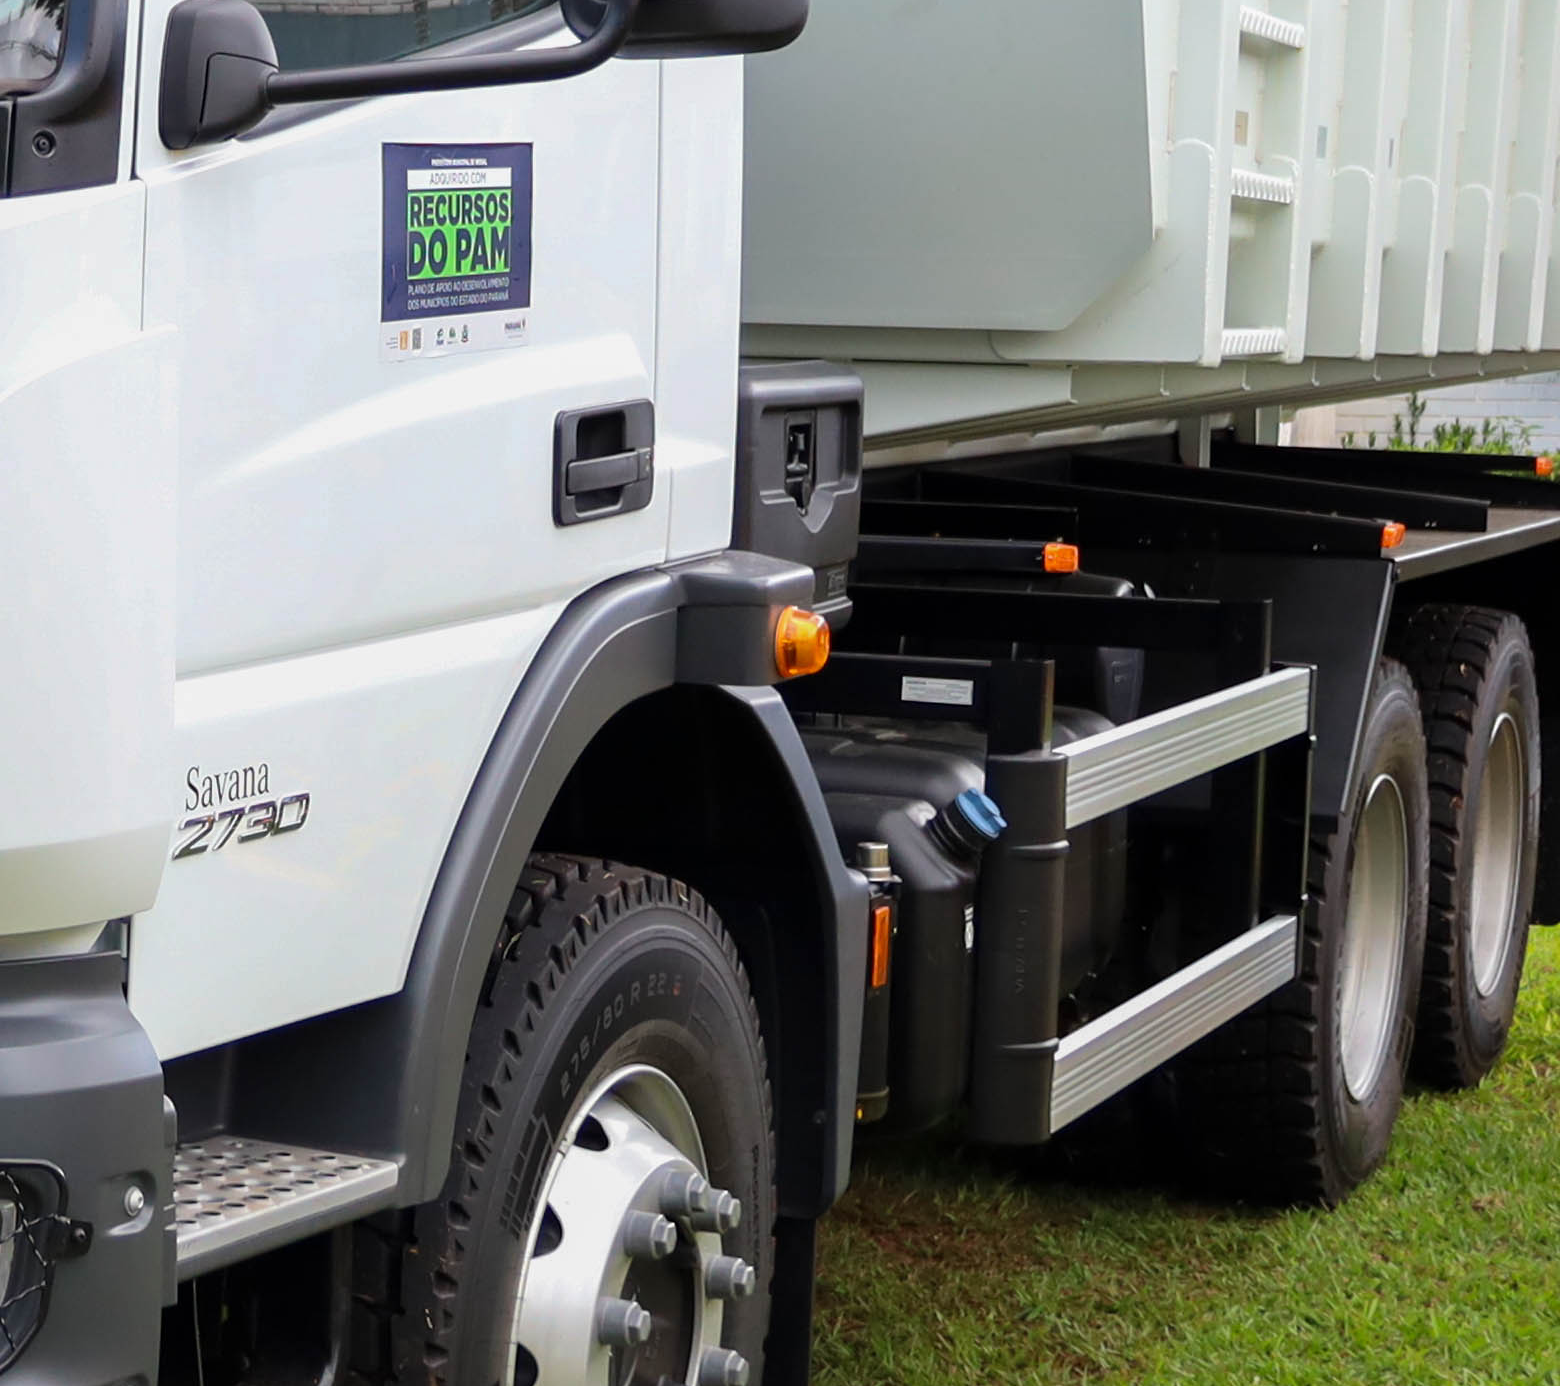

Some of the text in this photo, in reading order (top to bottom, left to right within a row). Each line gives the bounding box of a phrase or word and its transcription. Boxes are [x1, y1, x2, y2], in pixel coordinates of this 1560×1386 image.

[430, 171, 487, 186] ADQUIRIDO COM
[409, 192, 510, 229] RECURSOS
[408, 225, 510, 278] DO PAM
[408, 284, 426, 295] PLANO
[408, 299, 420, 310] DOS
[450, 295, 458, 306] DO
[185, 762, 270, 812] Savana
[171, 792, 310, 862] 2730
[559, 993, 625, 1100] 275/80
[629, 980, 641, 1006] R
